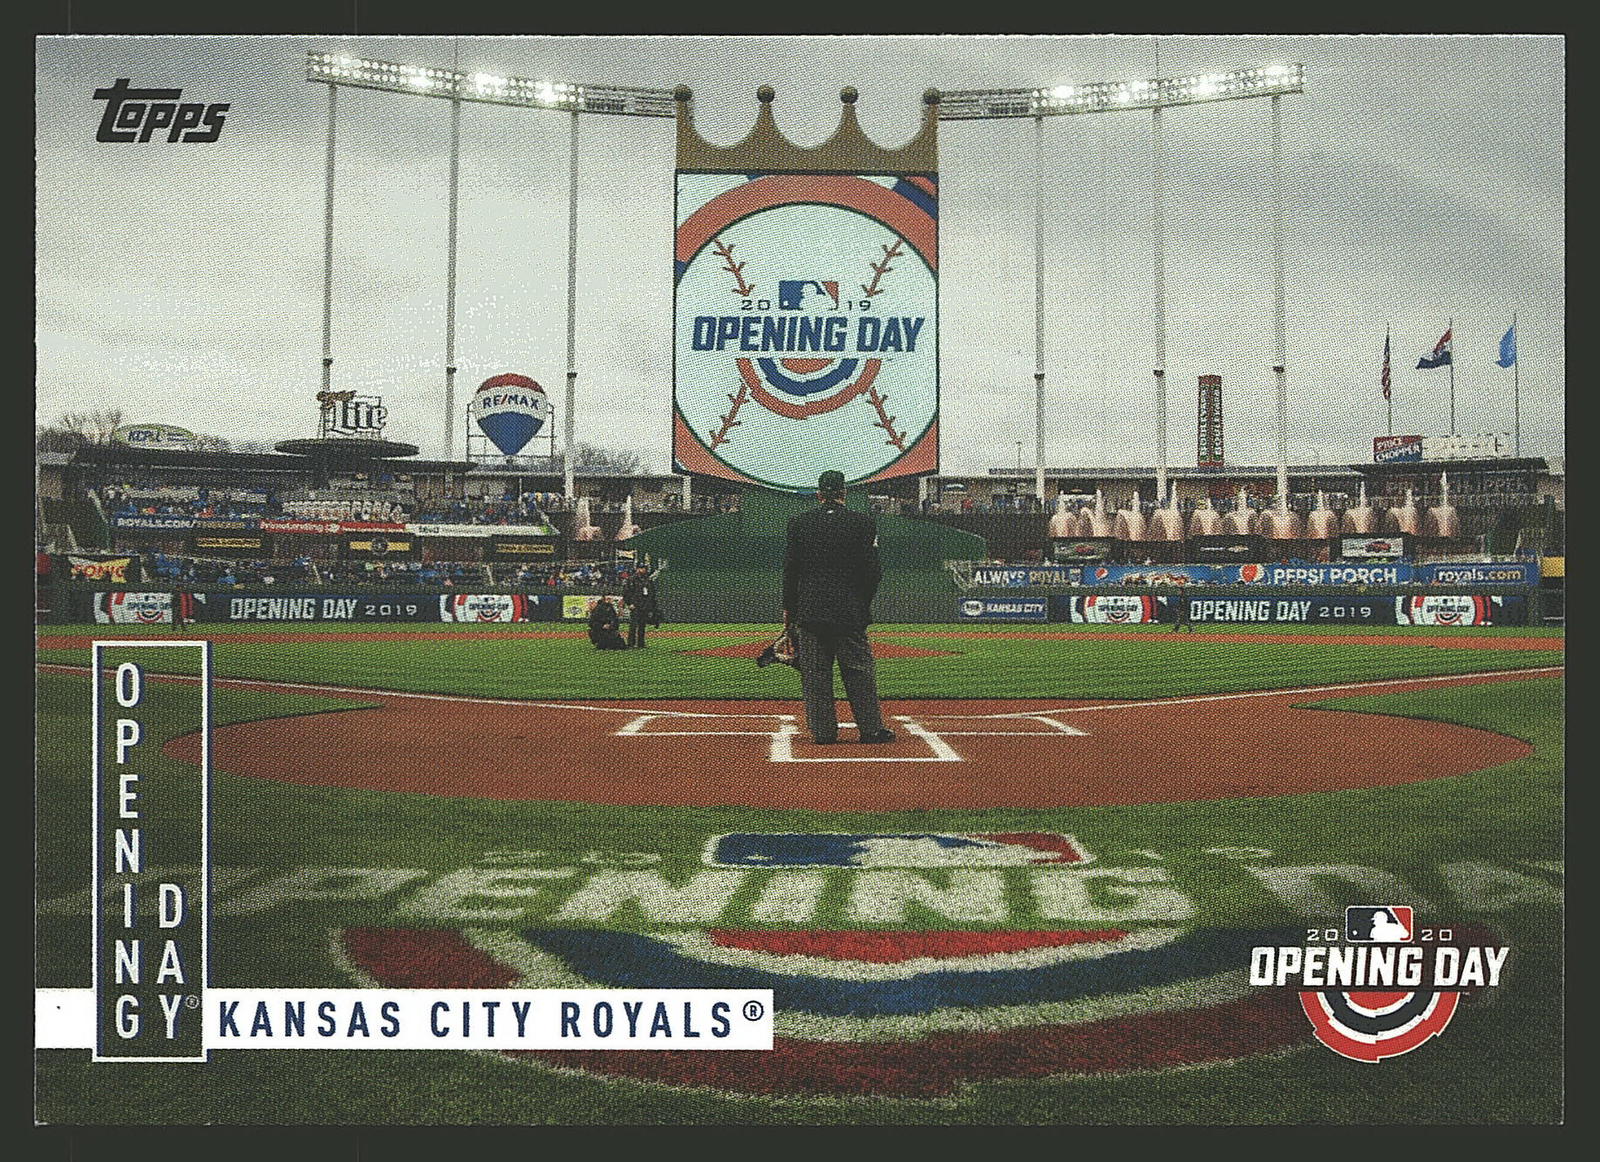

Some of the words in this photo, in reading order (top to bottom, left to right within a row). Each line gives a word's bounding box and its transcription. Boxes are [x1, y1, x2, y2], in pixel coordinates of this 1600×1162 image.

[741, 300, 771, 311] 20
[848, 300, 871, 311] 19
[691, 316, 849, 352] OPENING
[856, 316, 926, 352] DAY
[482, 393, 540, 411] RE/MAX
[1028, 570, 1067, 584] ROYAL
[1273, 568, 1325, 585] PEPSI
[1329, 567, 1397, 585] PORCH
[1436, 568, 1522, 583] royals.com
[230, 598, 316, 619] OPENING
[322, 598, 358, 619] DAY
[364, 604, 418, 616] 2019
[1189, 600, 1271, 621] OPENING
[1275, 600, 1311, 621] DAY
[1318, 606, 1372, 618] 2019
